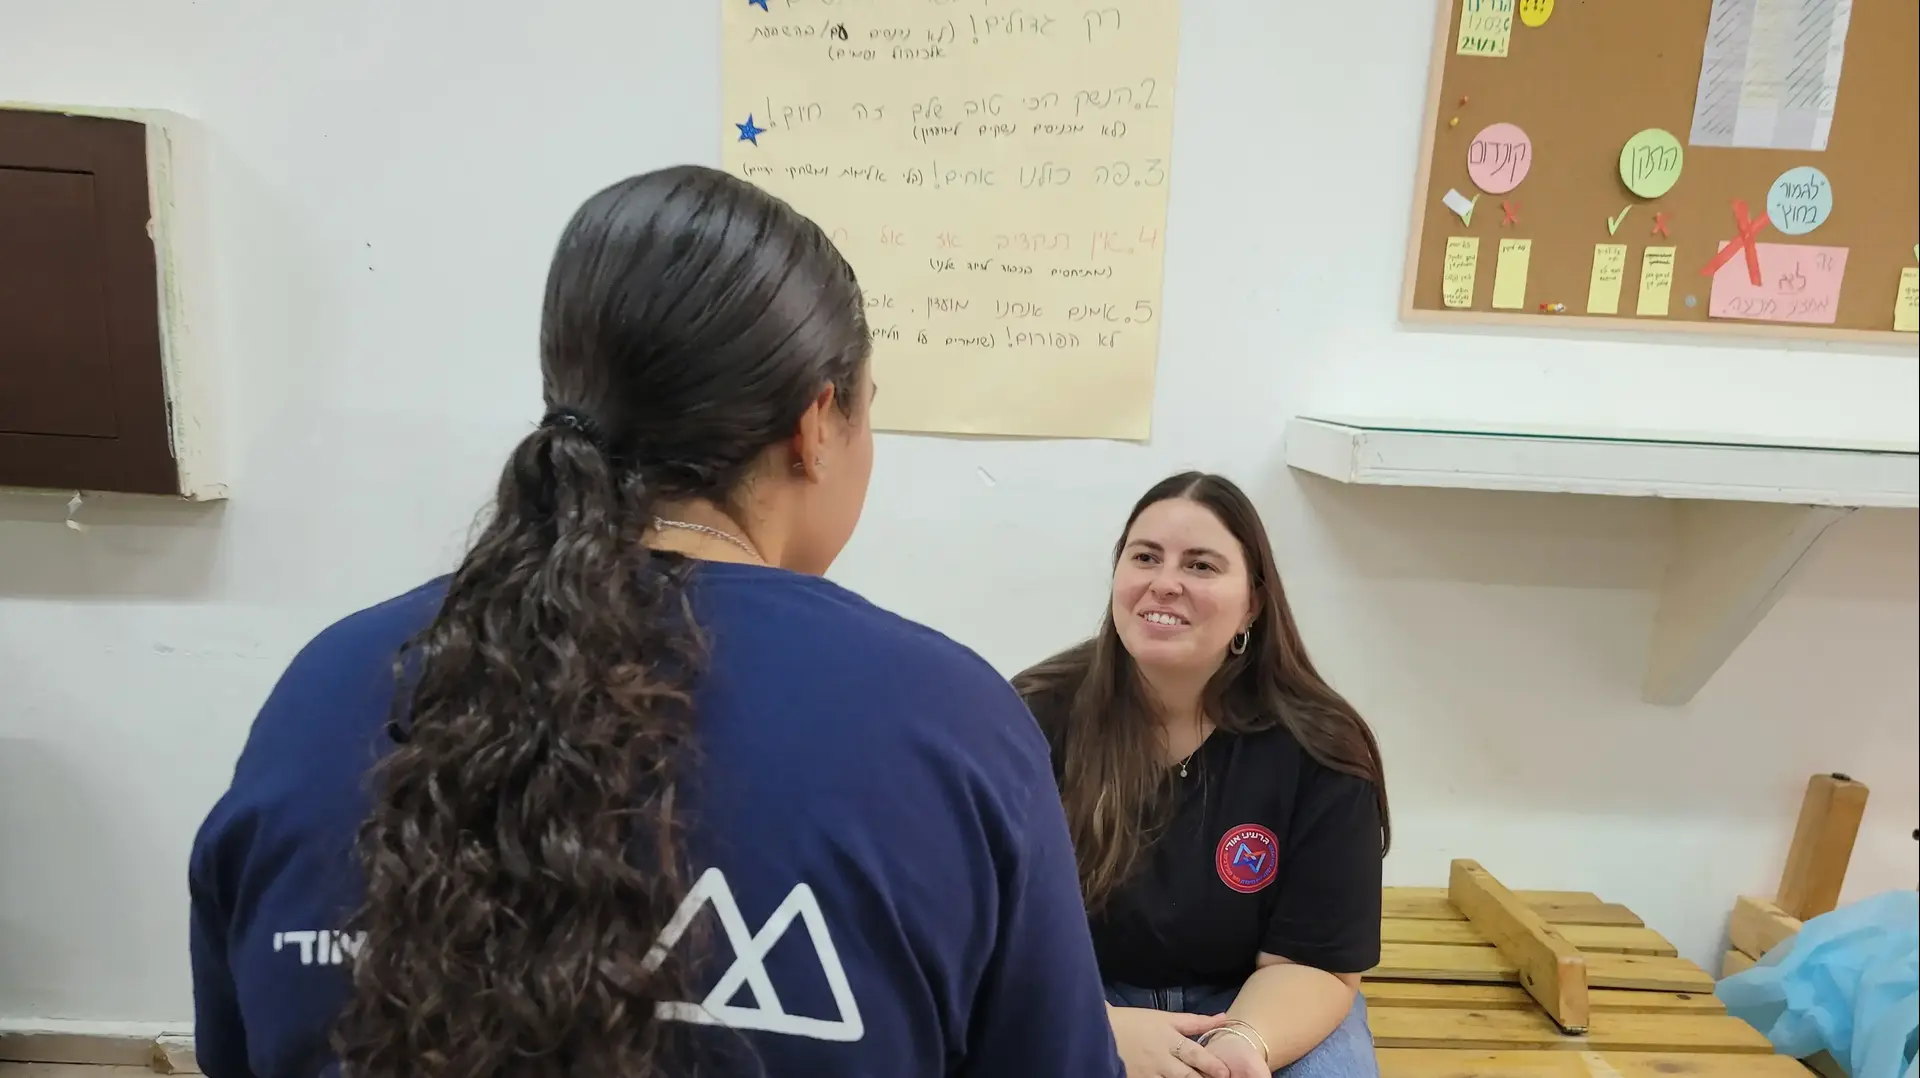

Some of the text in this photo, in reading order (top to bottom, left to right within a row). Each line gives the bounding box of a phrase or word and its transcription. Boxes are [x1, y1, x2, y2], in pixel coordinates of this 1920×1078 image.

[963, 93, 1004, 116] טוב
[1022, 92, 1059, 111] הכי
[1470, 140, 1526, 182] קונדום
[1631, 145, 1678, 188] התקן
